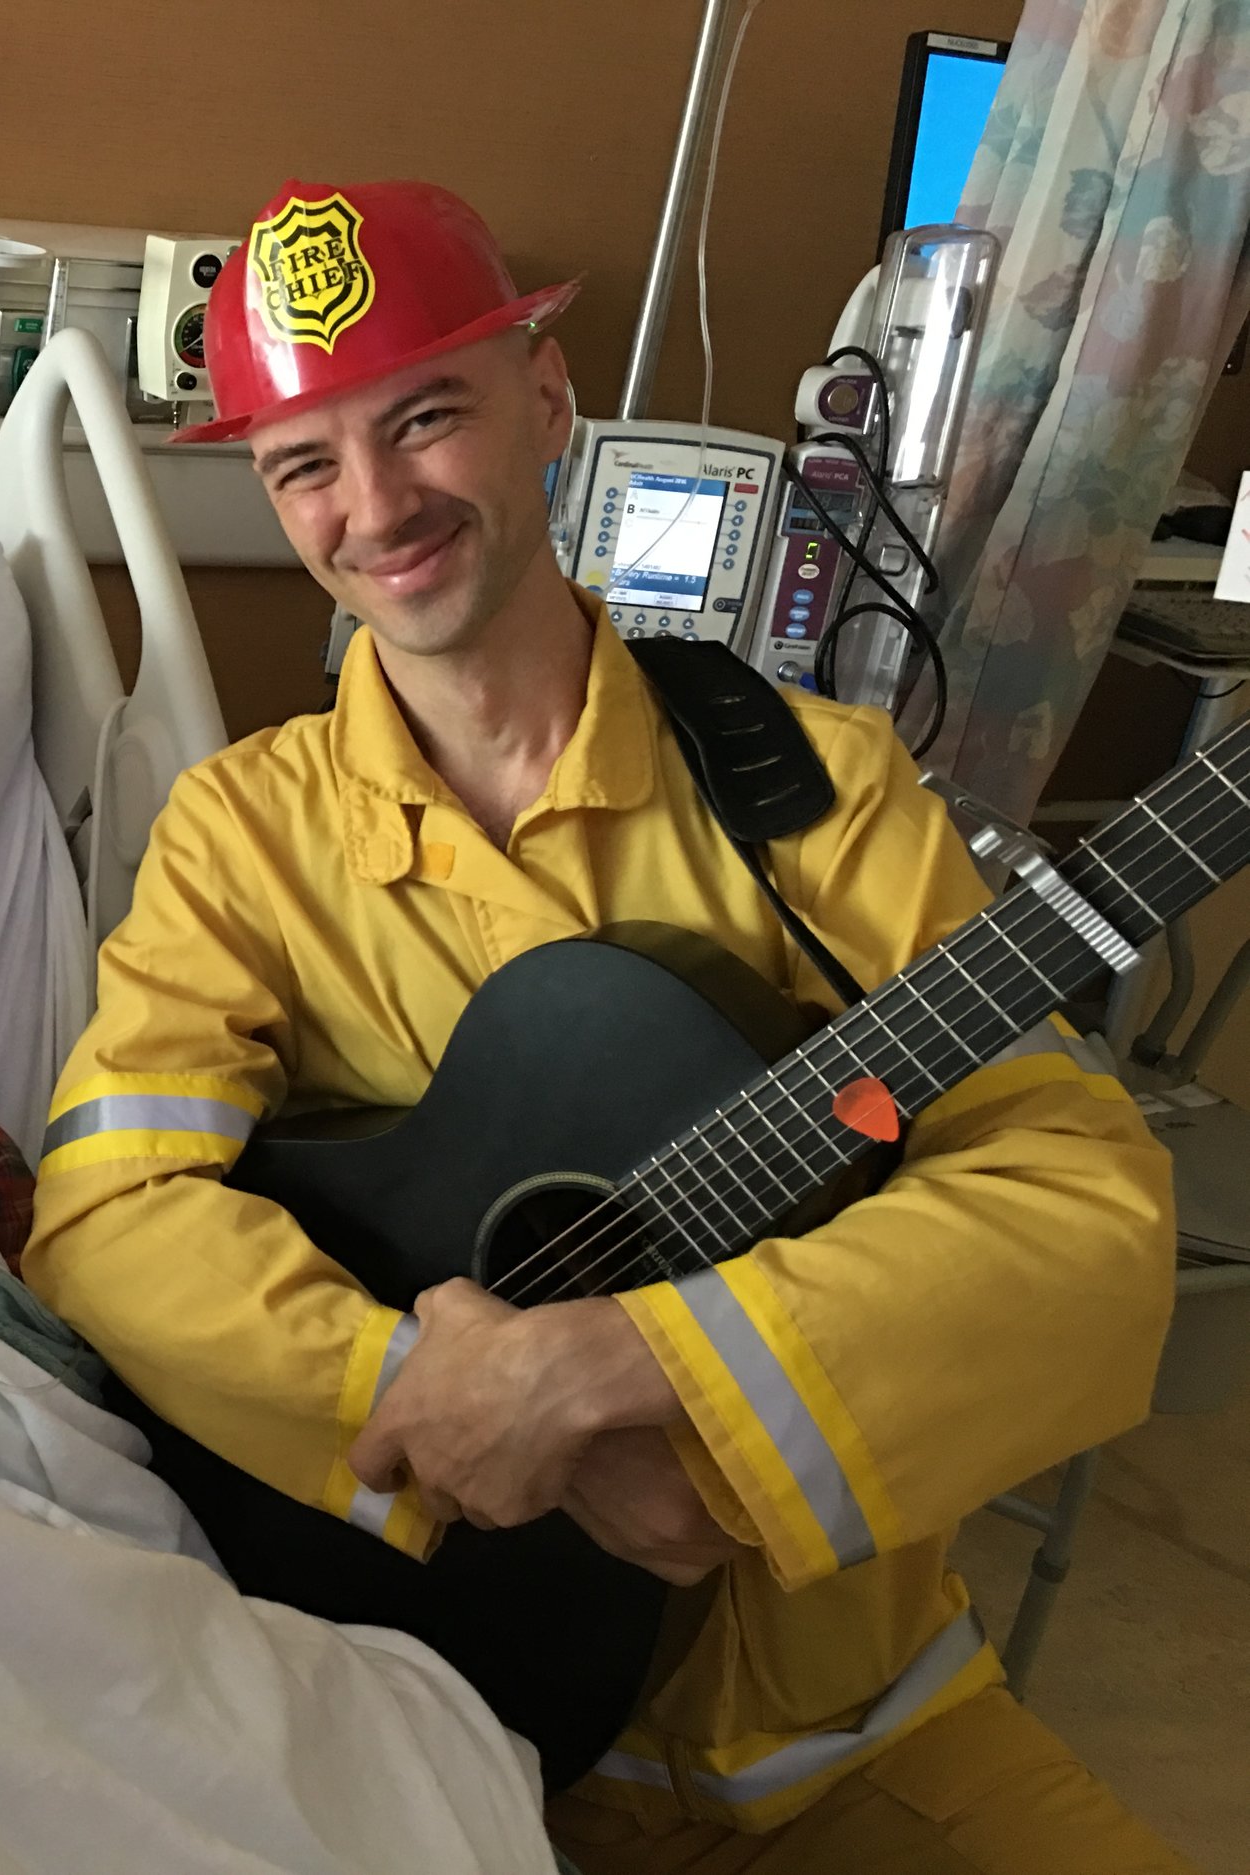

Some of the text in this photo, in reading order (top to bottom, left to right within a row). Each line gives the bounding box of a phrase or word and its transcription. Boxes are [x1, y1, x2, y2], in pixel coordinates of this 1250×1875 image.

[270, 236, 346, 281] FIRE
[266, 258, 363, 310] CHIEF
[736, 466, 755, 480] PC
[834, 472, 849, 480] PCA
[626, 504, 636, 514] B
